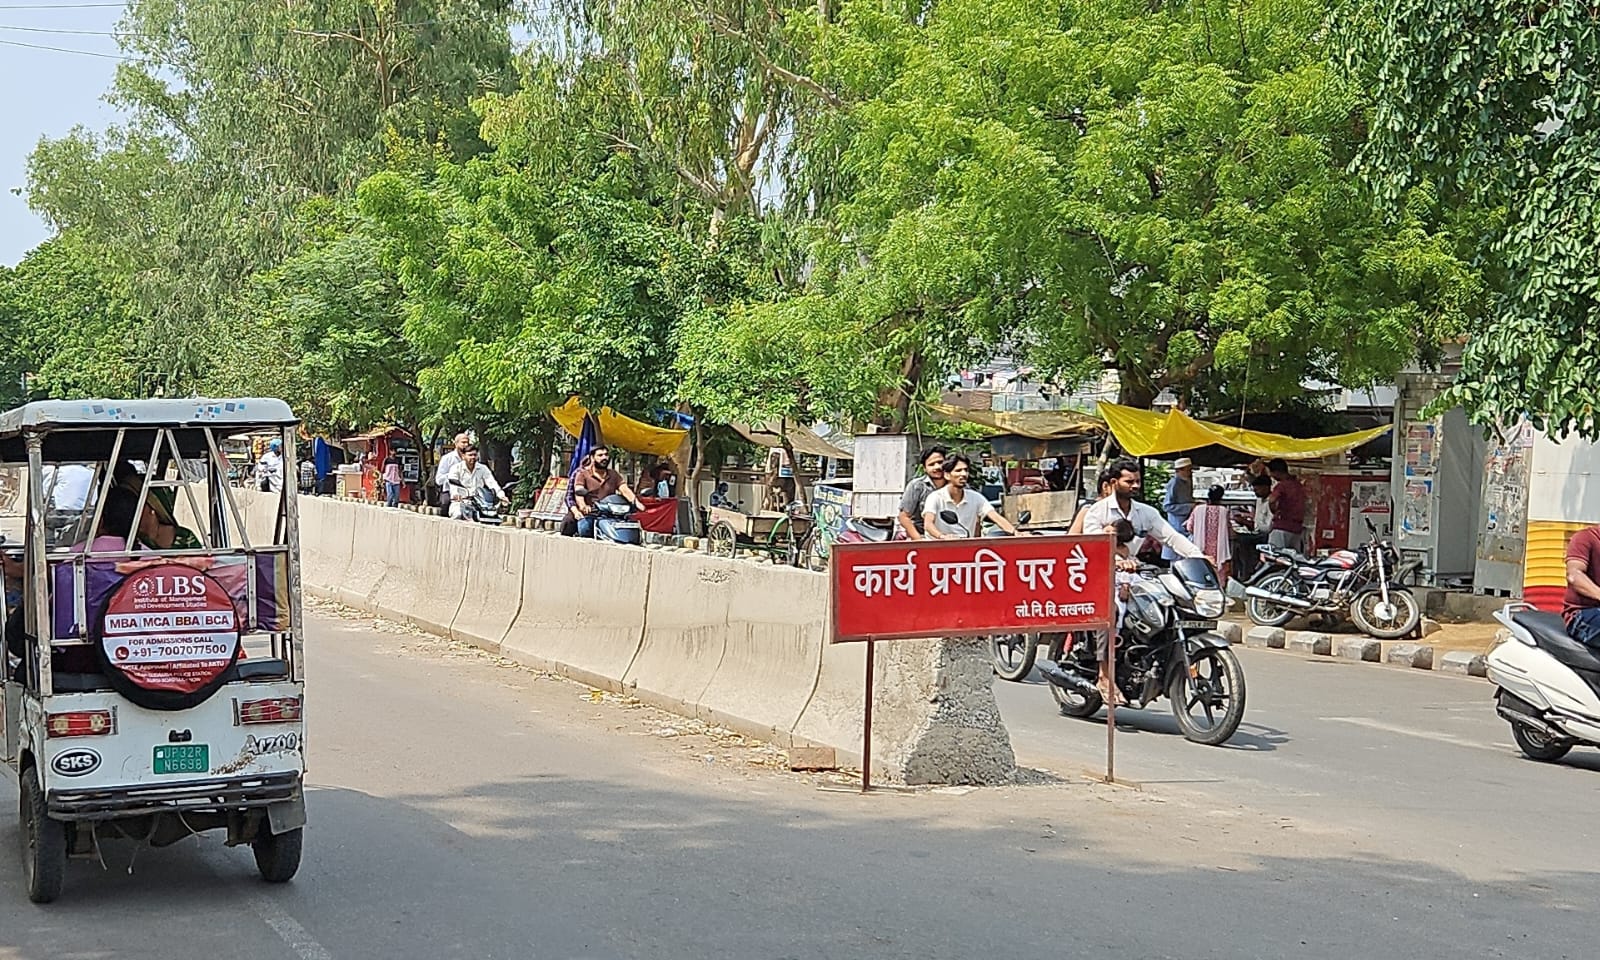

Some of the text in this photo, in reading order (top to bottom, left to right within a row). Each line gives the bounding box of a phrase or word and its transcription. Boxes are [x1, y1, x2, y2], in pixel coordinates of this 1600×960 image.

[852, 544, 1089, 597] कार्य प्रगति पर है
[155, 575, 206, 596] LBS
[109, 615, 229, 629] MBA MCA BBA BCA
[146, 637, 193, 645] ADMISSIONS
[132, 644, 227, 657] +91-7007077500
[164, 746, 202, 759] UP32R
[60, 754, 93, 770] SKS
